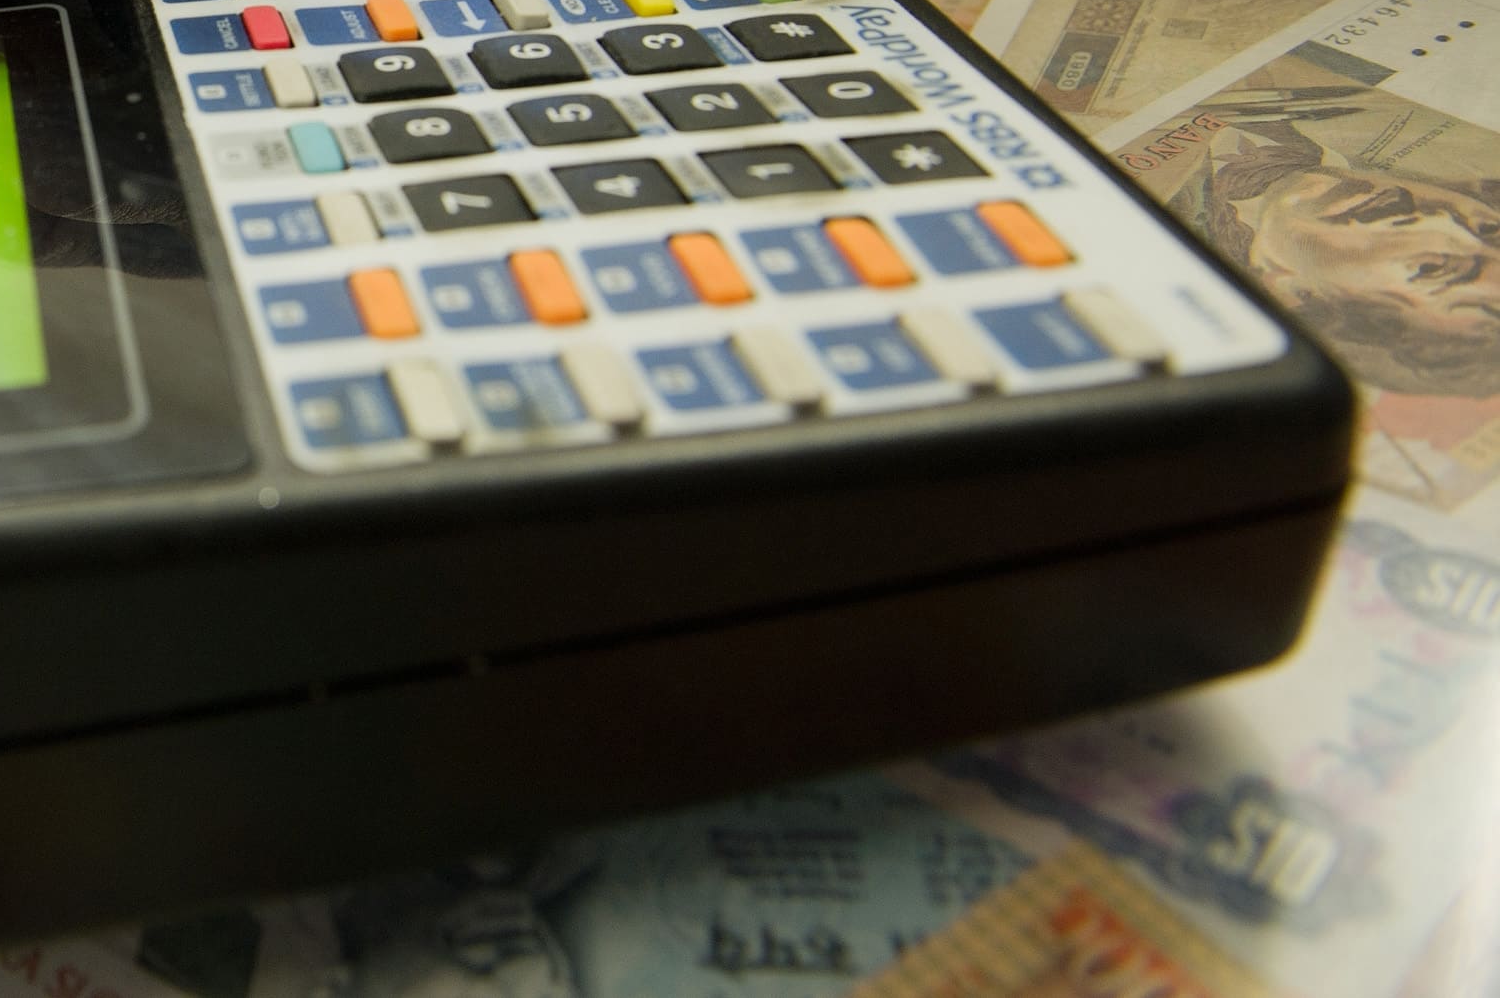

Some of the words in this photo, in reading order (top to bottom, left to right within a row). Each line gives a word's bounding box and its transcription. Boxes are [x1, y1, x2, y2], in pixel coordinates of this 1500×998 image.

[216, 17, 238, 49] CANCEL
[642, 32, 684, 50] 3
[510, 42, 552, 59] 6
[840, 3, 978, 110] WorldPay
[373, 54, 416, 72] 9
[827, 81, 874, 100] 0
[691, 93, 739, 112] 2
[546, 103, 593, 122] 5
[405, 116, 451, 137] 8
[1118, 112, 1231, 178] BANQ
[747, 163, 794, 180] 1
[594, 175, 641, 198] 4
[441, 192, 493, 215] 7
